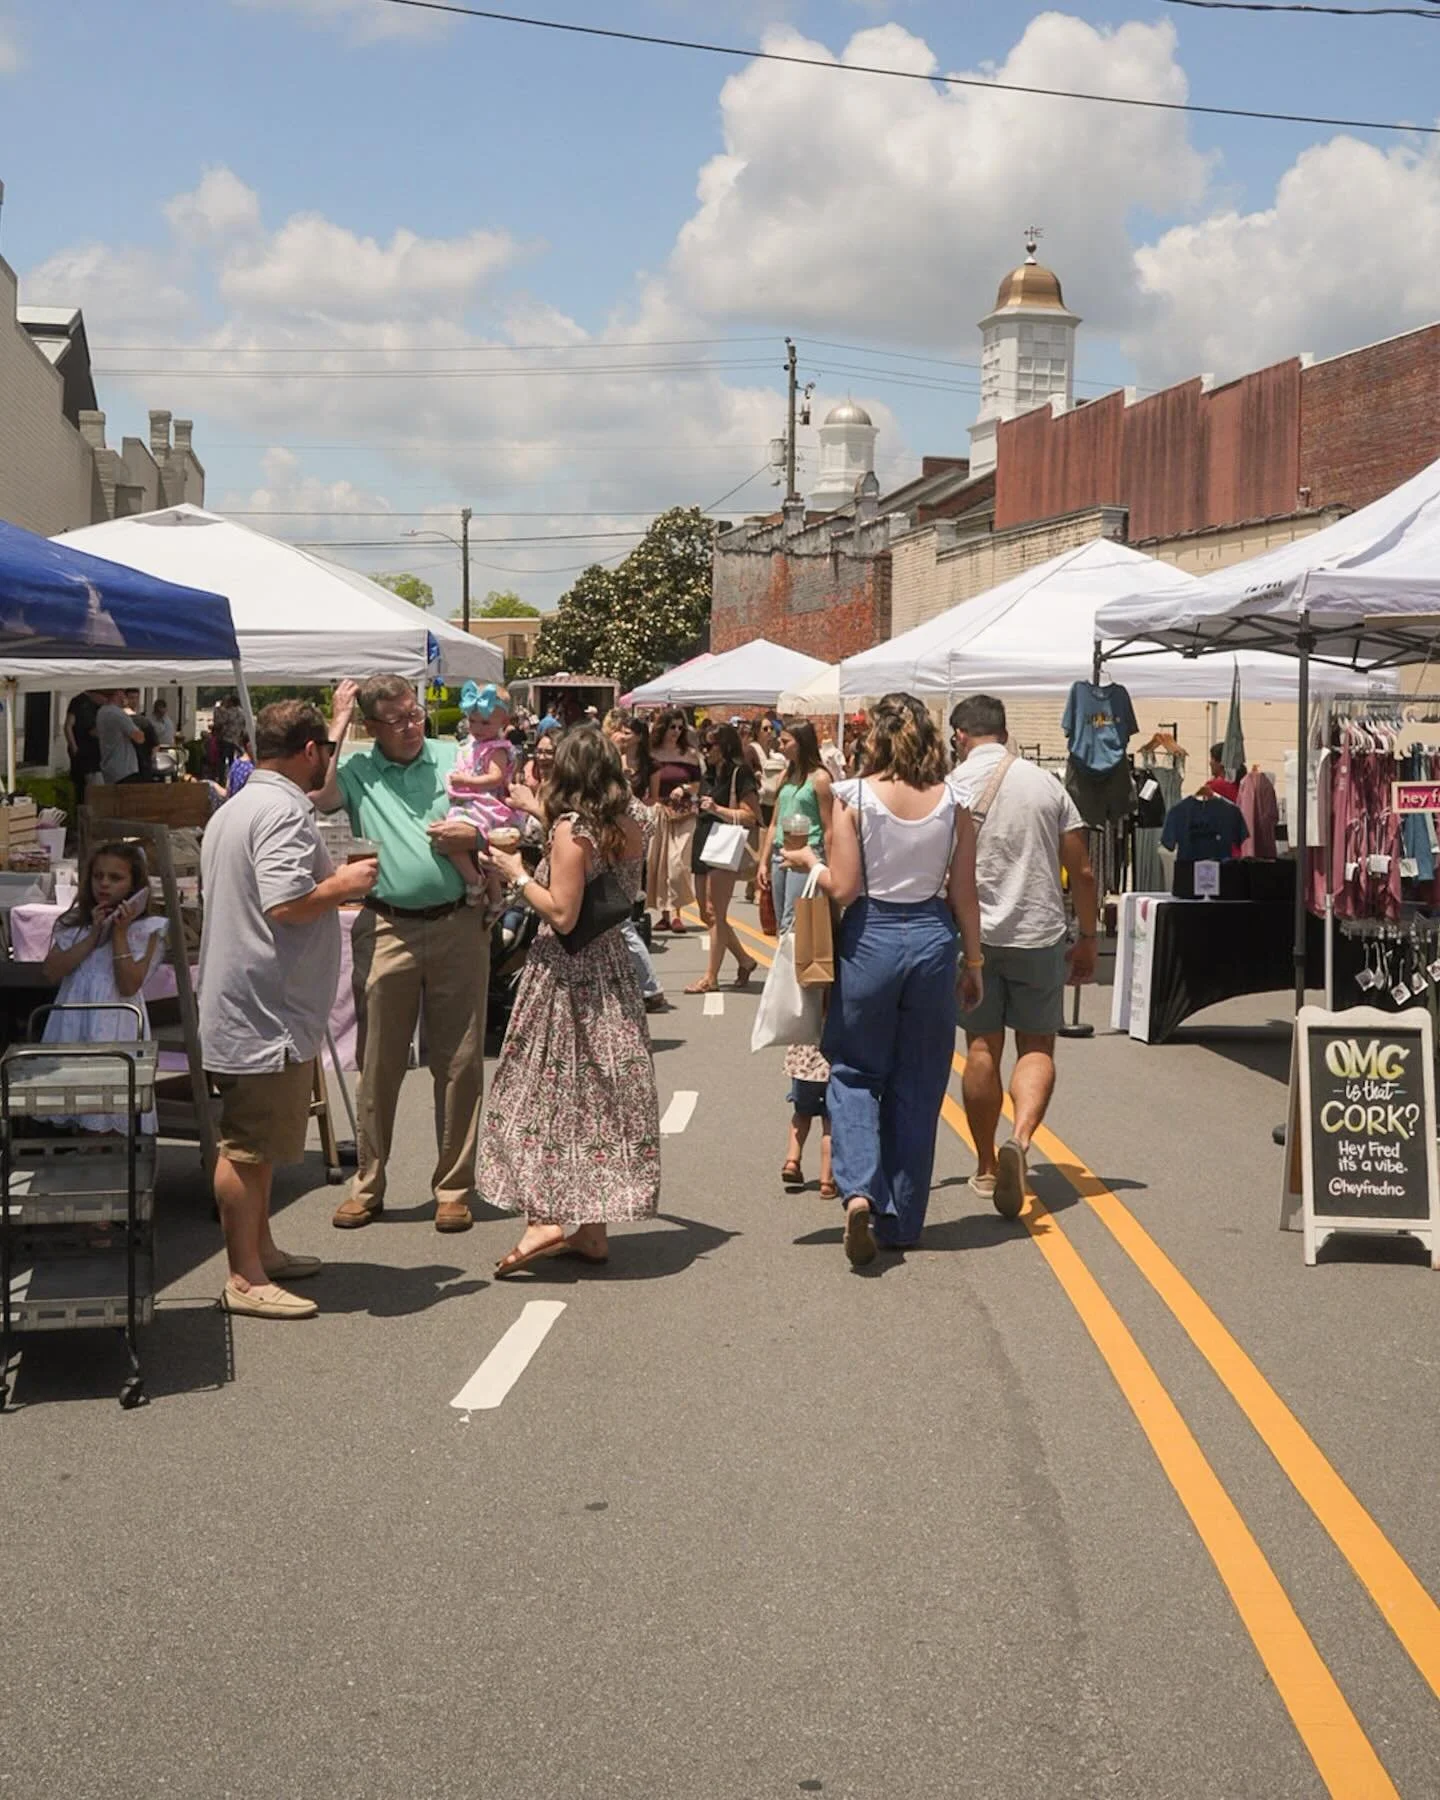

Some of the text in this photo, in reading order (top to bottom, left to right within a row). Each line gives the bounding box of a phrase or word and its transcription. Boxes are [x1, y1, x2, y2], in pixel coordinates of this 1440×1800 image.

[1400, 789, 1428, 807] hey
[1325, 1039, 1410, 1080] OMG
[1346, 1080, 1400, 1102] is that
[1320, 1100, 1420, 1140] CORK?
[1338, 1140, 1400, 1160] Hey Fred
[1338, 1156, 1408, 1173] it's a vibe.
[1328, 1177, 1405, 1197] @heyfrednc
